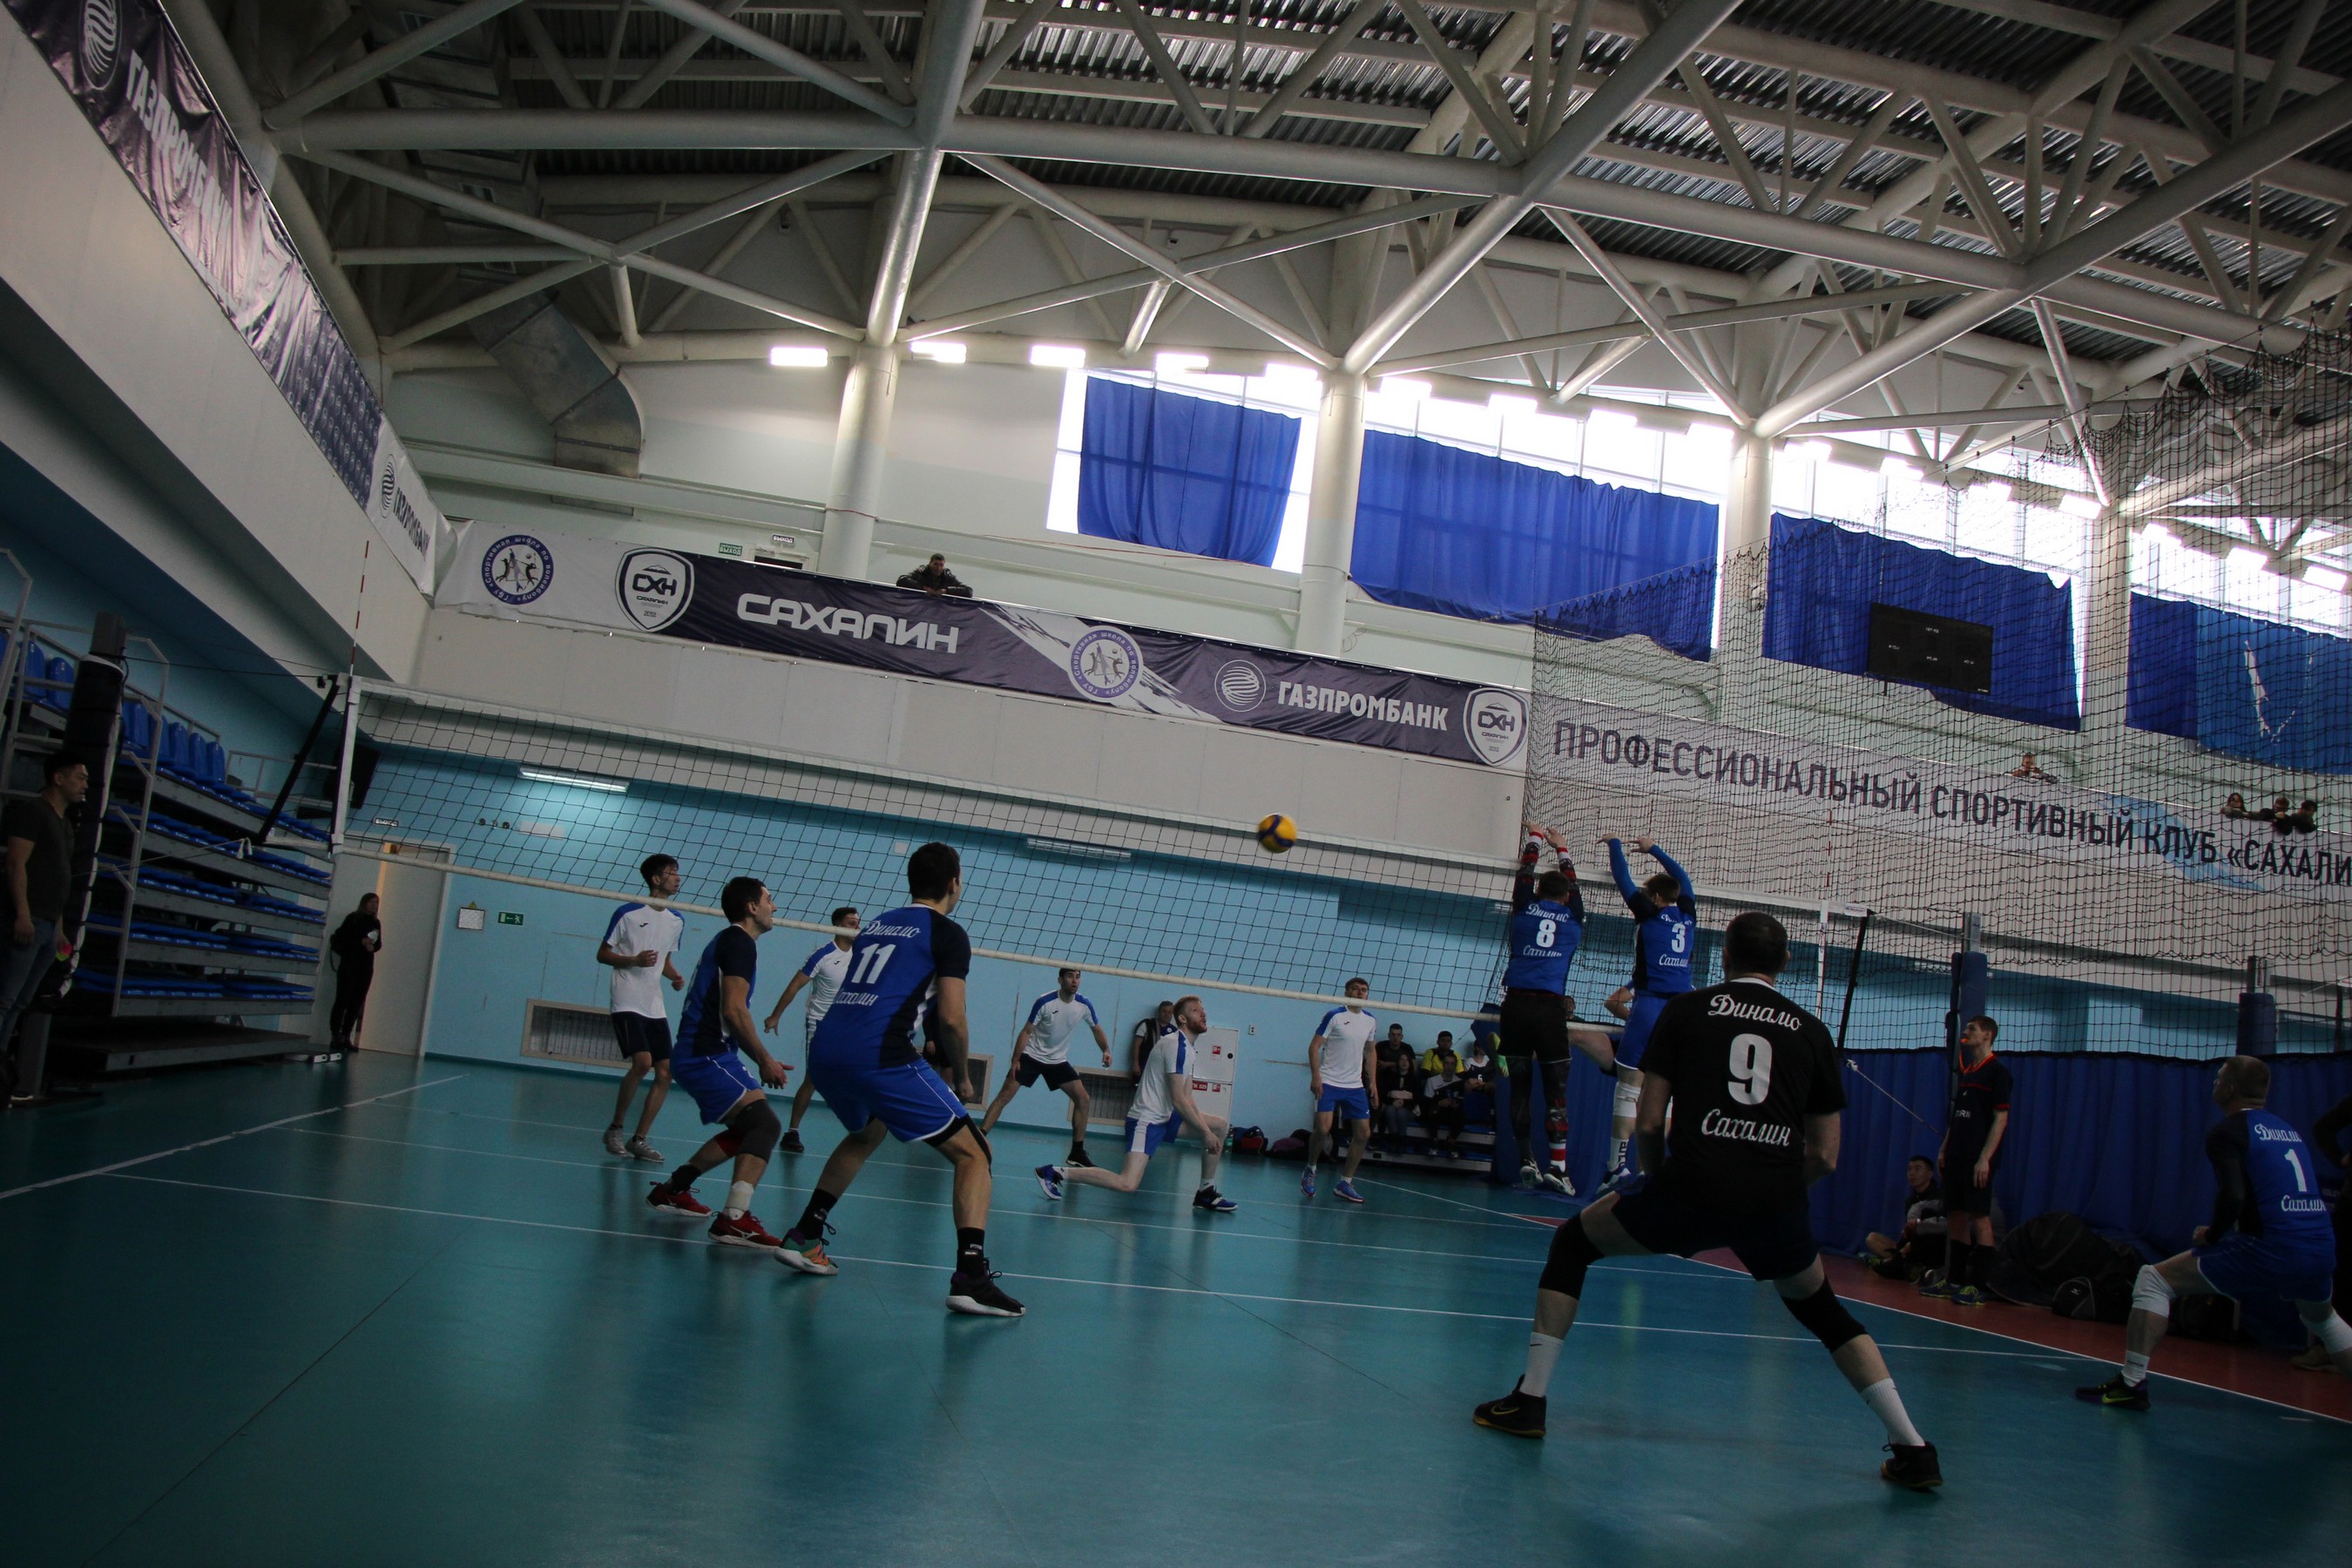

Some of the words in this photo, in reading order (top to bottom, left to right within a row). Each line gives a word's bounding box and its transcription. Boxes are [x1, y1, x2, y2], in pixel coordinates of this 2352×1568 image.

[515, 537, 540, 549] школа
[541, 550, 550, 561] по
[720, 547, 741, 556] ВЫХОД
[644, 610, 657, 618] 2012
[737, 592, 959, 654] САХАЛИН
[1101, 632, 1125, 645] школа
[1126, 645, 1134, 656] по
[1278, 680, 1450, 731] ГАЗПРОМБАНК
[1553, 719, 1921, 814] ПРОФЕССИОНАЛЬНЫЙ
[1931, 784, 2133, 850] СПОРТИВНЫЙ
[2145, 823, 2217, 863] КЛУБ
[861, 919, 921, 938] Динамо
[1536, 918, 1557, 948] 8
[1671, 923, 1686, 953] 3
[851, 943, 896, 984] 11
[1707, 994, 1802, 1031] Динамо
[1727, 1033, 1773, 1105] 9
[1701, 1108, 1791, 1146] Сахалин
[2284, 1148, 2307, 1193] 1
[2281, 1194, 2327, 1212] Сахалин
